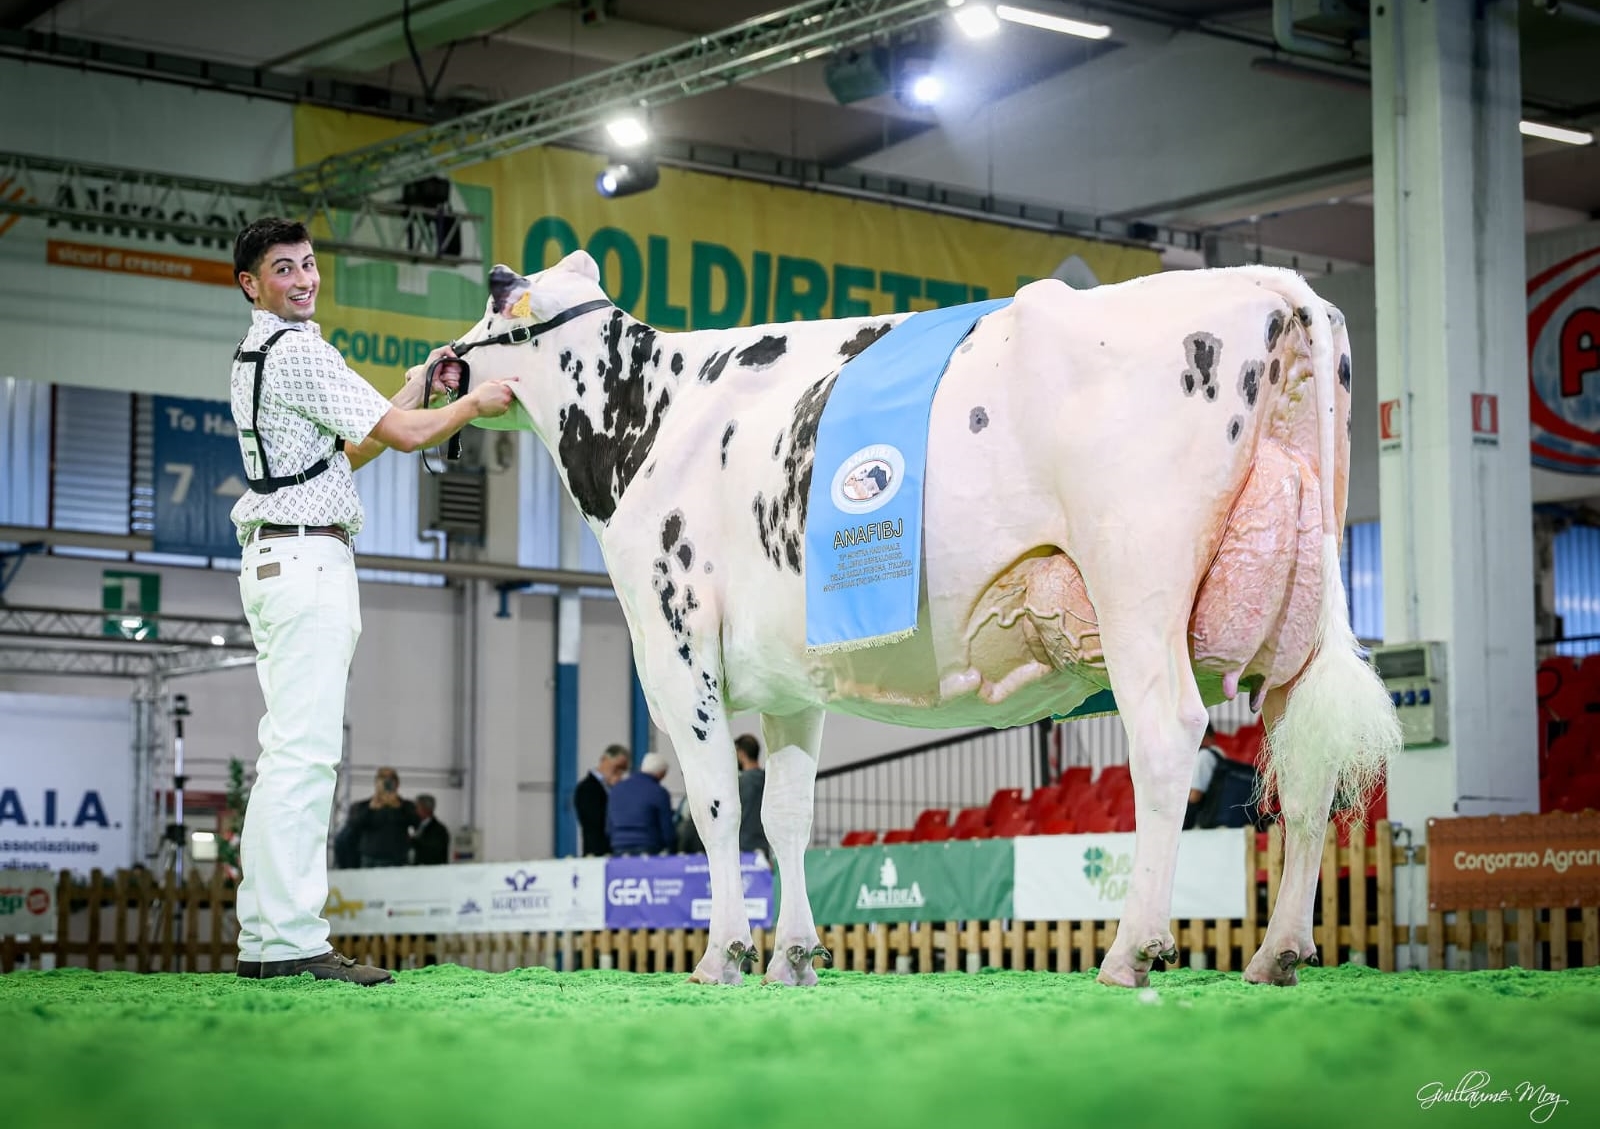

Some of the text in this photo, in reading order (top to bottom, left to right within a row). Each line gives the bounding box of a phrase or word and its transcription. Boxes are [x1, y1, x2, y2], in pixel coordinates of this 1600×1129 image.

[105, 253, 122, 269] di
[522, 215, 990, 332] COLDIRETT
[331, 327, 450, 369] COLDIR
[165, 407, 196, 432] To
[164, 463, 194, 504] 7
[833, 518, 904, 550] ANAFIBJ
[0, 789, 122, 828] A.I.A.
[1454, 851, 1539, 873] Consorzio
[607, 878, 654, 906] GEA
